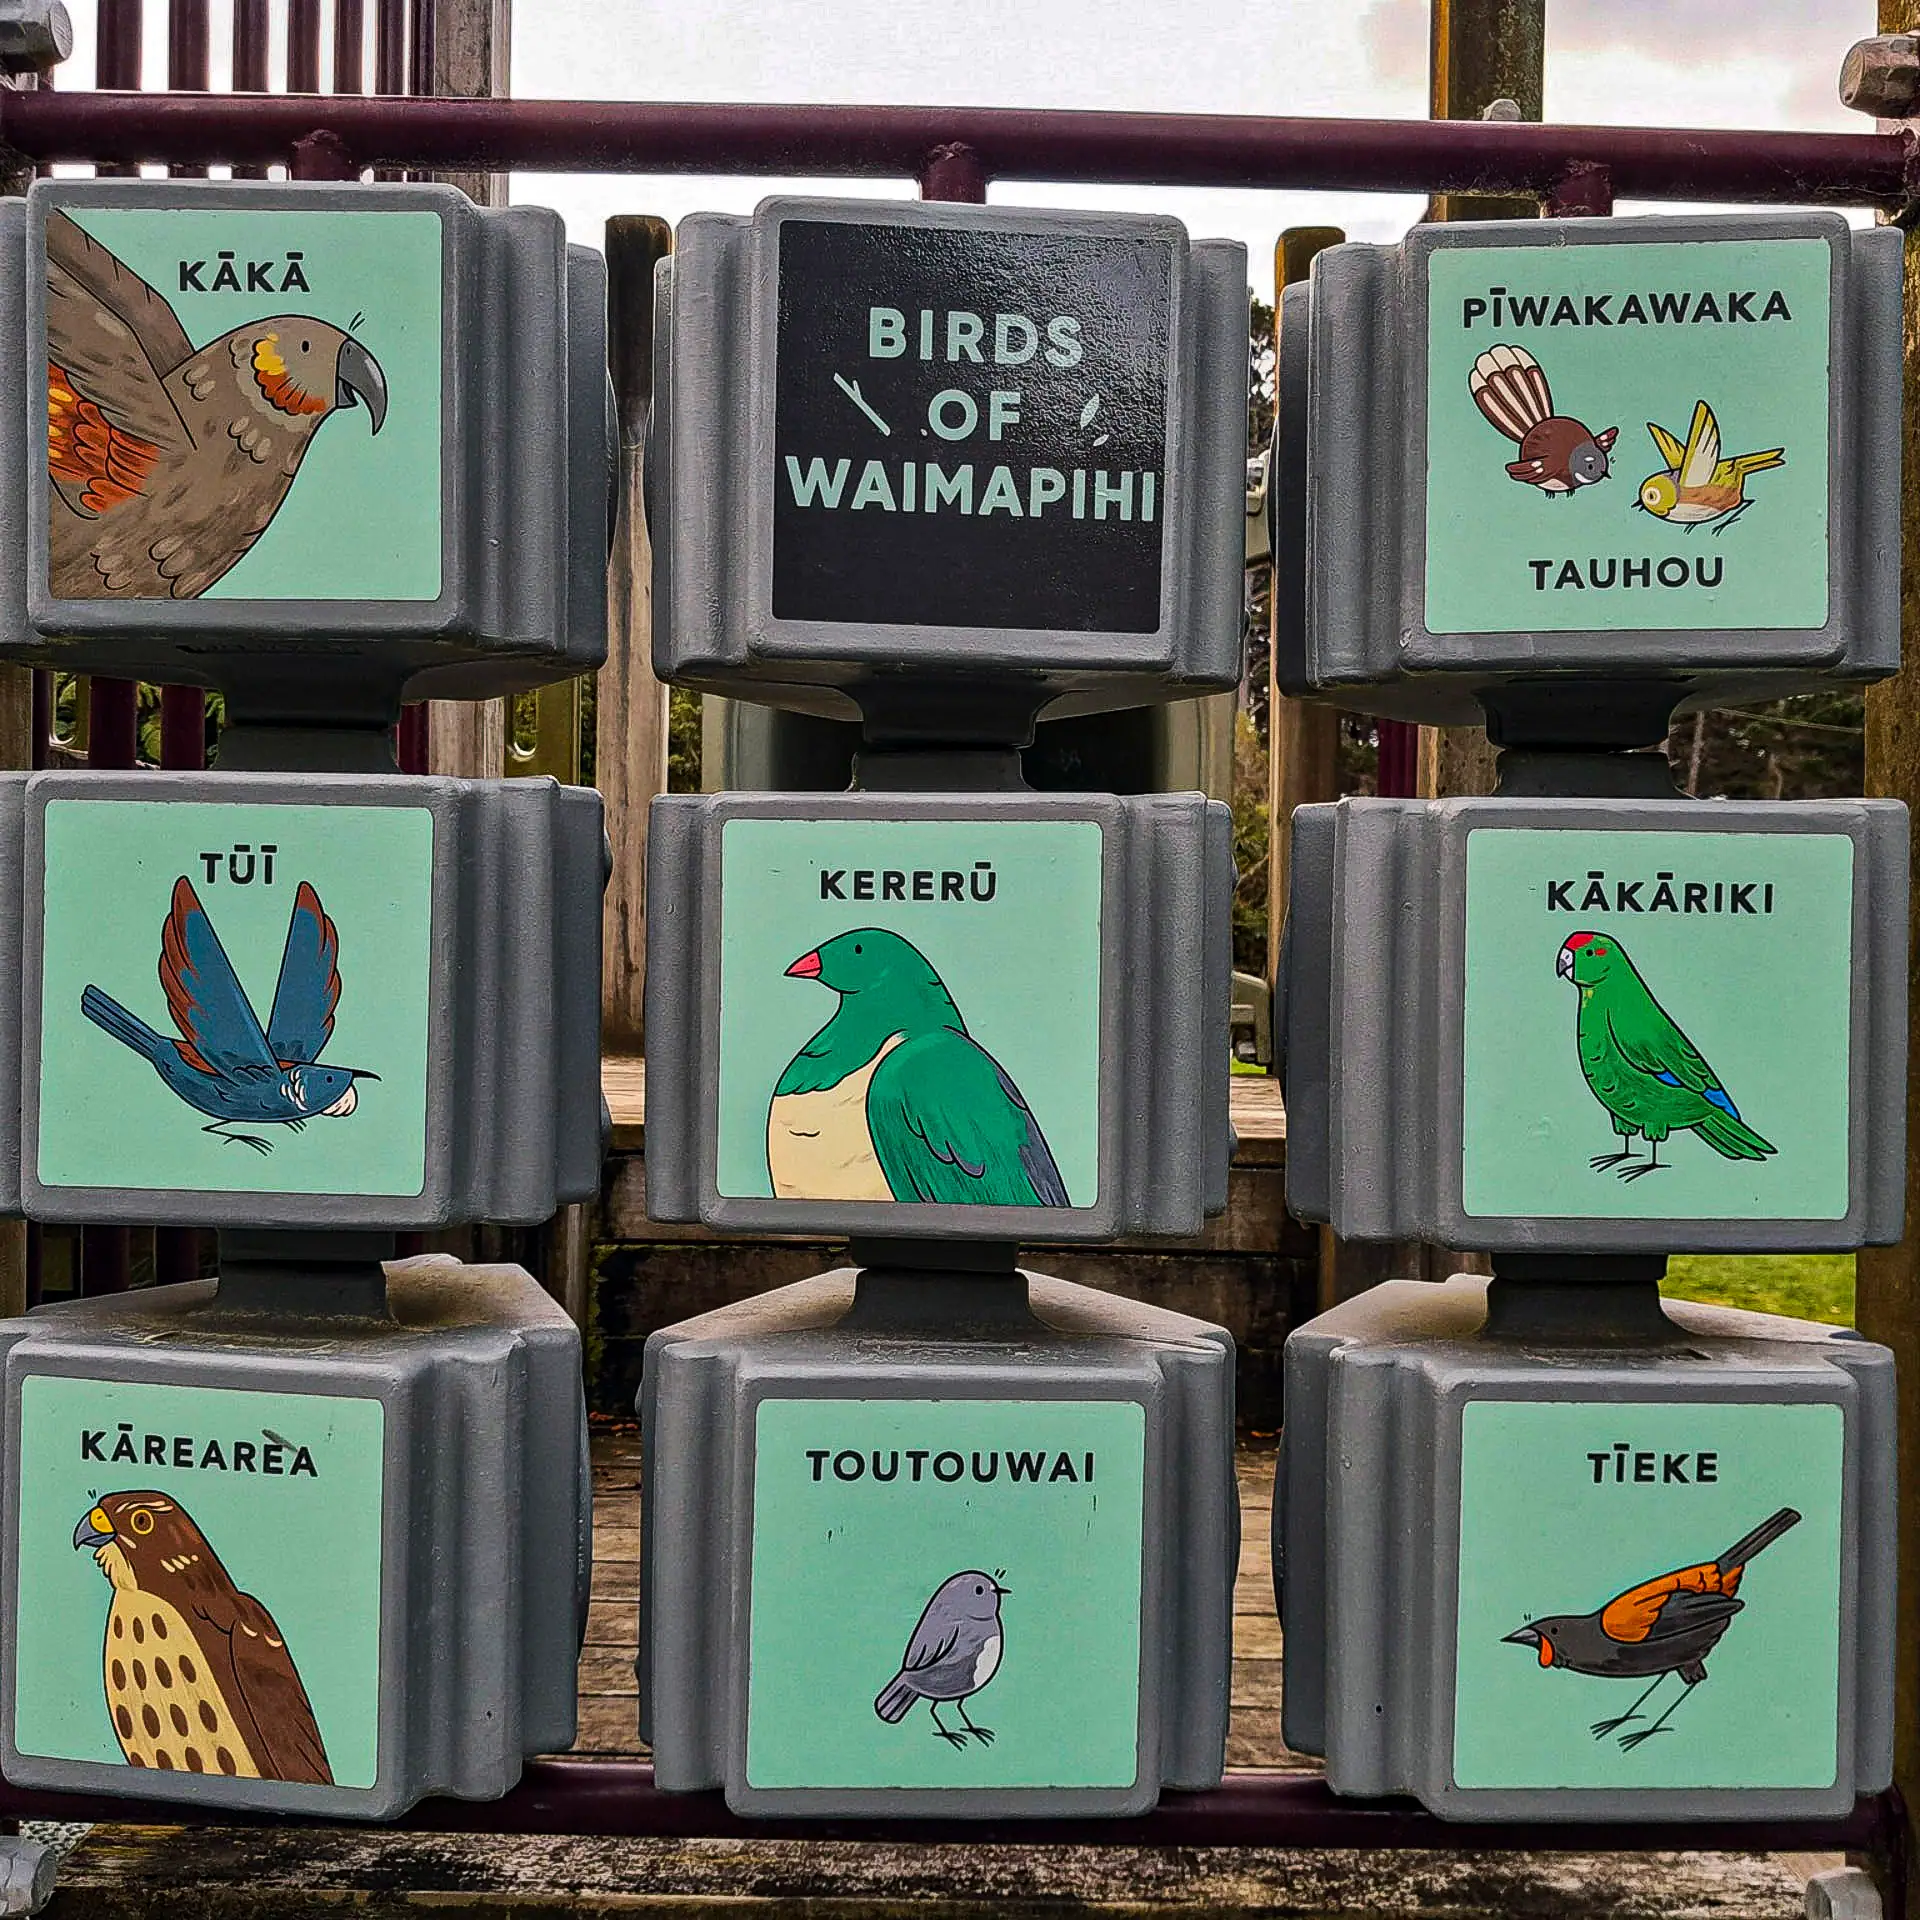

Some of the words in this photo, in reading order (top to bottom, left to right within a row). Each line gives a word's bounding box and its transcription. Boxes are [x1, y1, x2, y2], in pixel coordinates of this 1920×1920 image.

[180, 251, 310, 292] KĀKĀ
[1464, 287, 1792, 329] PĪWAKAWAKA
[870, 306, 1084, 367] BIRDS
[929, 389, 1021, 441] OF
[785, 456, 1155, 522] WAIMAPIHI
[1529, 557, 1723, 591] TAUHOU
[199, 845, 278, 885] TŪĪ
[821, 862, 997, 902] KERERŪ
[1548, 871, 1774, 914] KĀKĀRIKI
[806, 1450, 1094, 1483] TOUTOUWAI
[1587, 1443, 1718, 1484] TĪEKE
